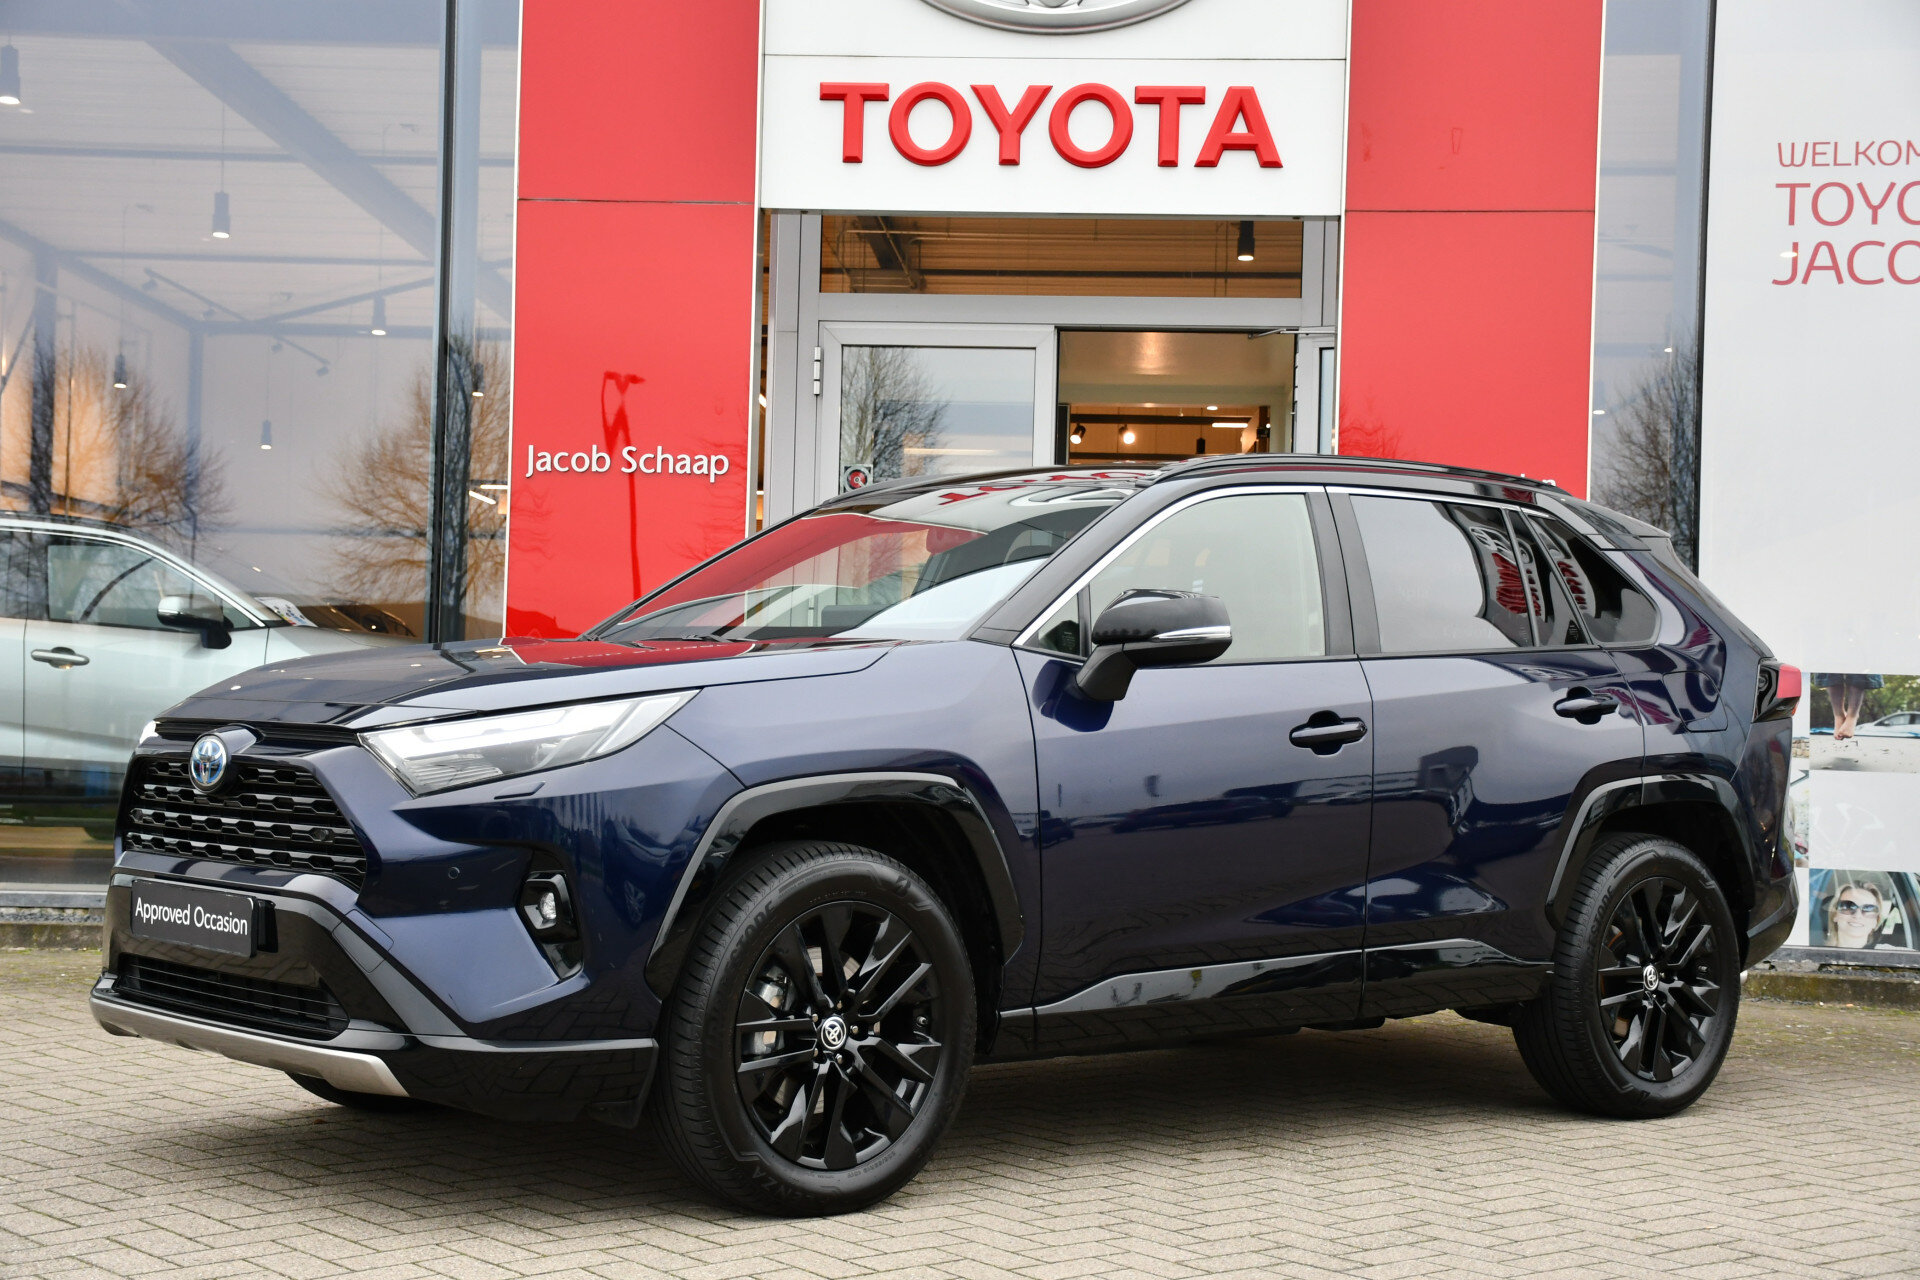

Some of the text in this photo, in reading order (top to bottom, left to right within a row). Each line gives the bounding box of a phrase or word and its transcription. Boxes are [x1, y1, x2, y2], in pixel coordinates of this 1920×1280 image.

[819, 81, 1284, 169] TOYOTA
[1775, 180, 1920, 226] TOYO
[1771, 239, 1920, 285] JACO
[525, 444, 730, 483] Jacob Schaap
[135, 896, 249, 935] Approved Occasion
